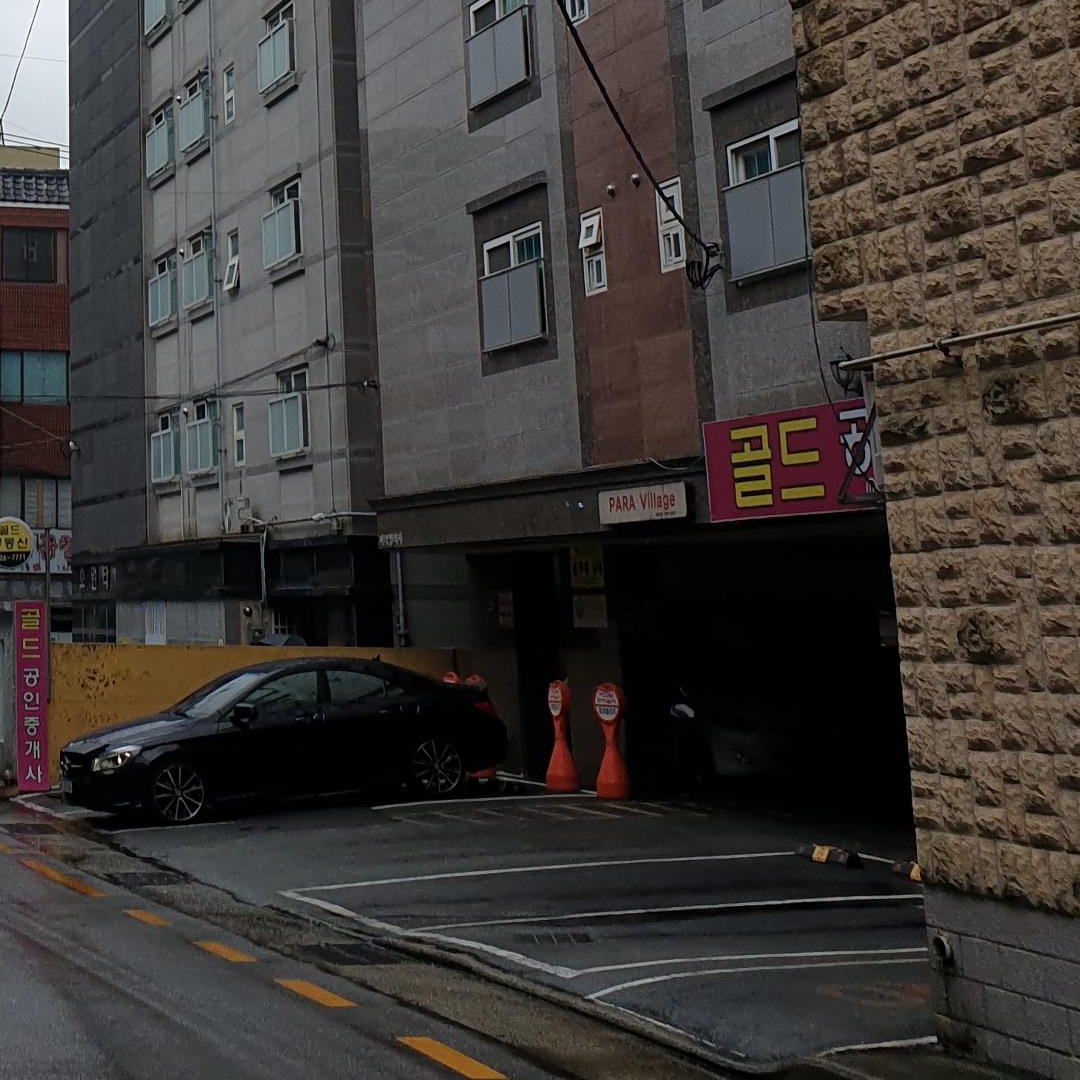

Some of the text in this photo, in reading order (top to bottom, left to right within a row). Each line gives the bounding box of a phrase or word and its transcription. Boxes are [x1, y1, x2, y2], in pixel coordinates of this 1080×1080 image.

[609, 491, 676, 513] PARA Village
[730, 417, 826, 509] 골드
[21, 608, 43, 784] 골드 공인중개사
